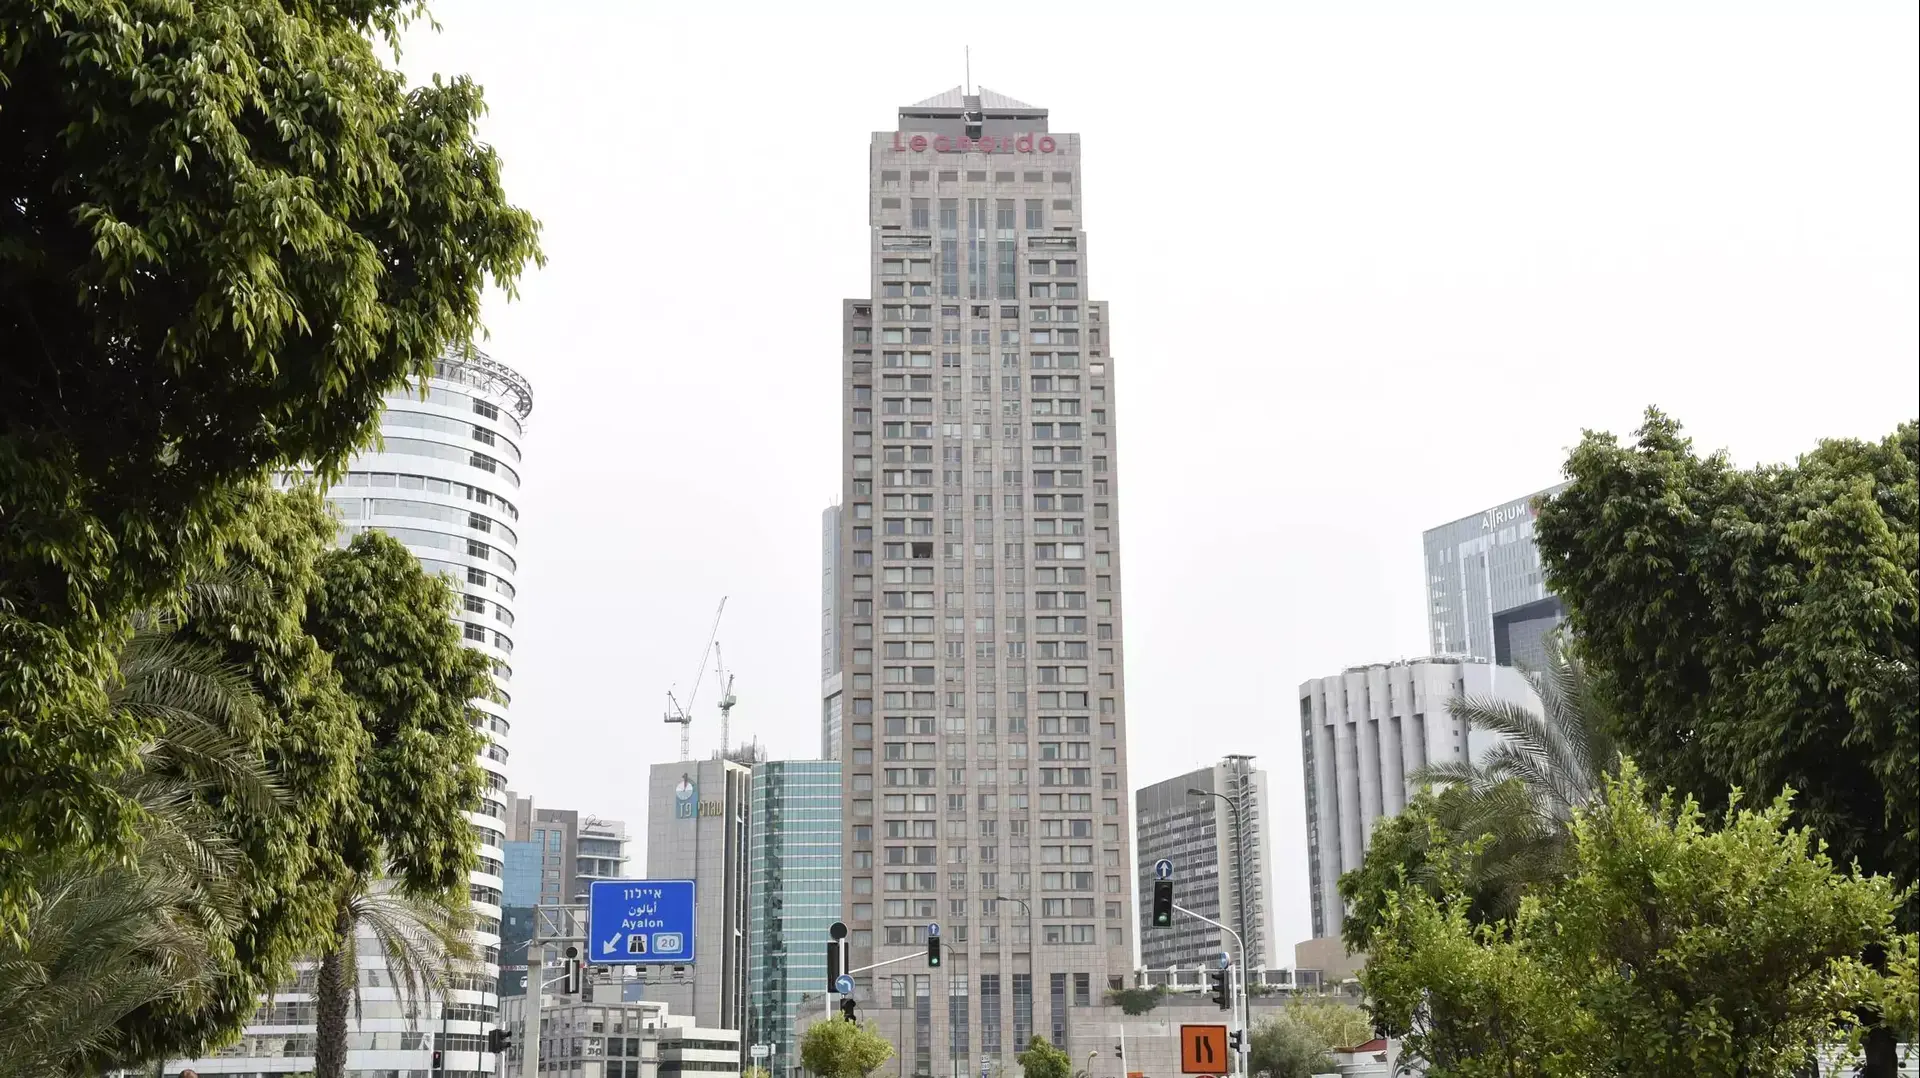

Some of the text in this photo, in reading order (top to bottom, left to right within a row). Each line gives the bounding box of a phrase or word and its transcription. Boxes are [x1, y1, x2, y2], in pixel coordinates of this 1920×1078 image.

[623, 888, 662, 901] איילון
[628, 902, 657, 917] أيالون
[621, 919, 664, 930] Ayalon
[661, 939, 675, 948] 20
